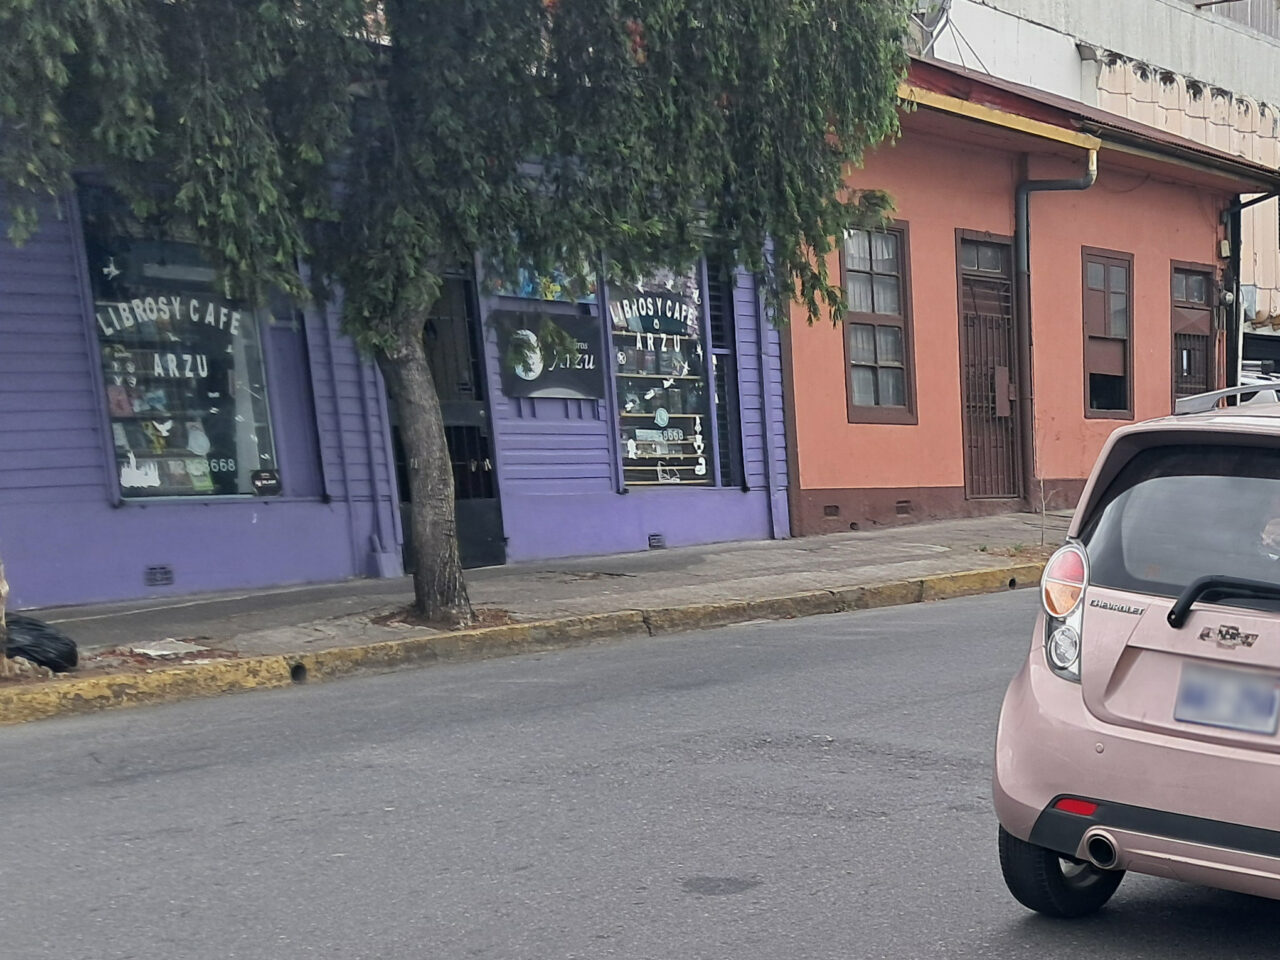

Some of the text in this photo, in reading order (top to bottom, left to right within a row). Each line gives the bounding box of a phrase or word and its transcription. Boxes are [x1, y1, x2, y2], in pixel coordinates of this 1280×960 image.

[189, 299, 241, 336] CAFE
[609, 297, 694, 326] LIBROS Y CAFE
[636, 332, 681, 353] ARZU
[154, 353, 208, 378] ARZU
